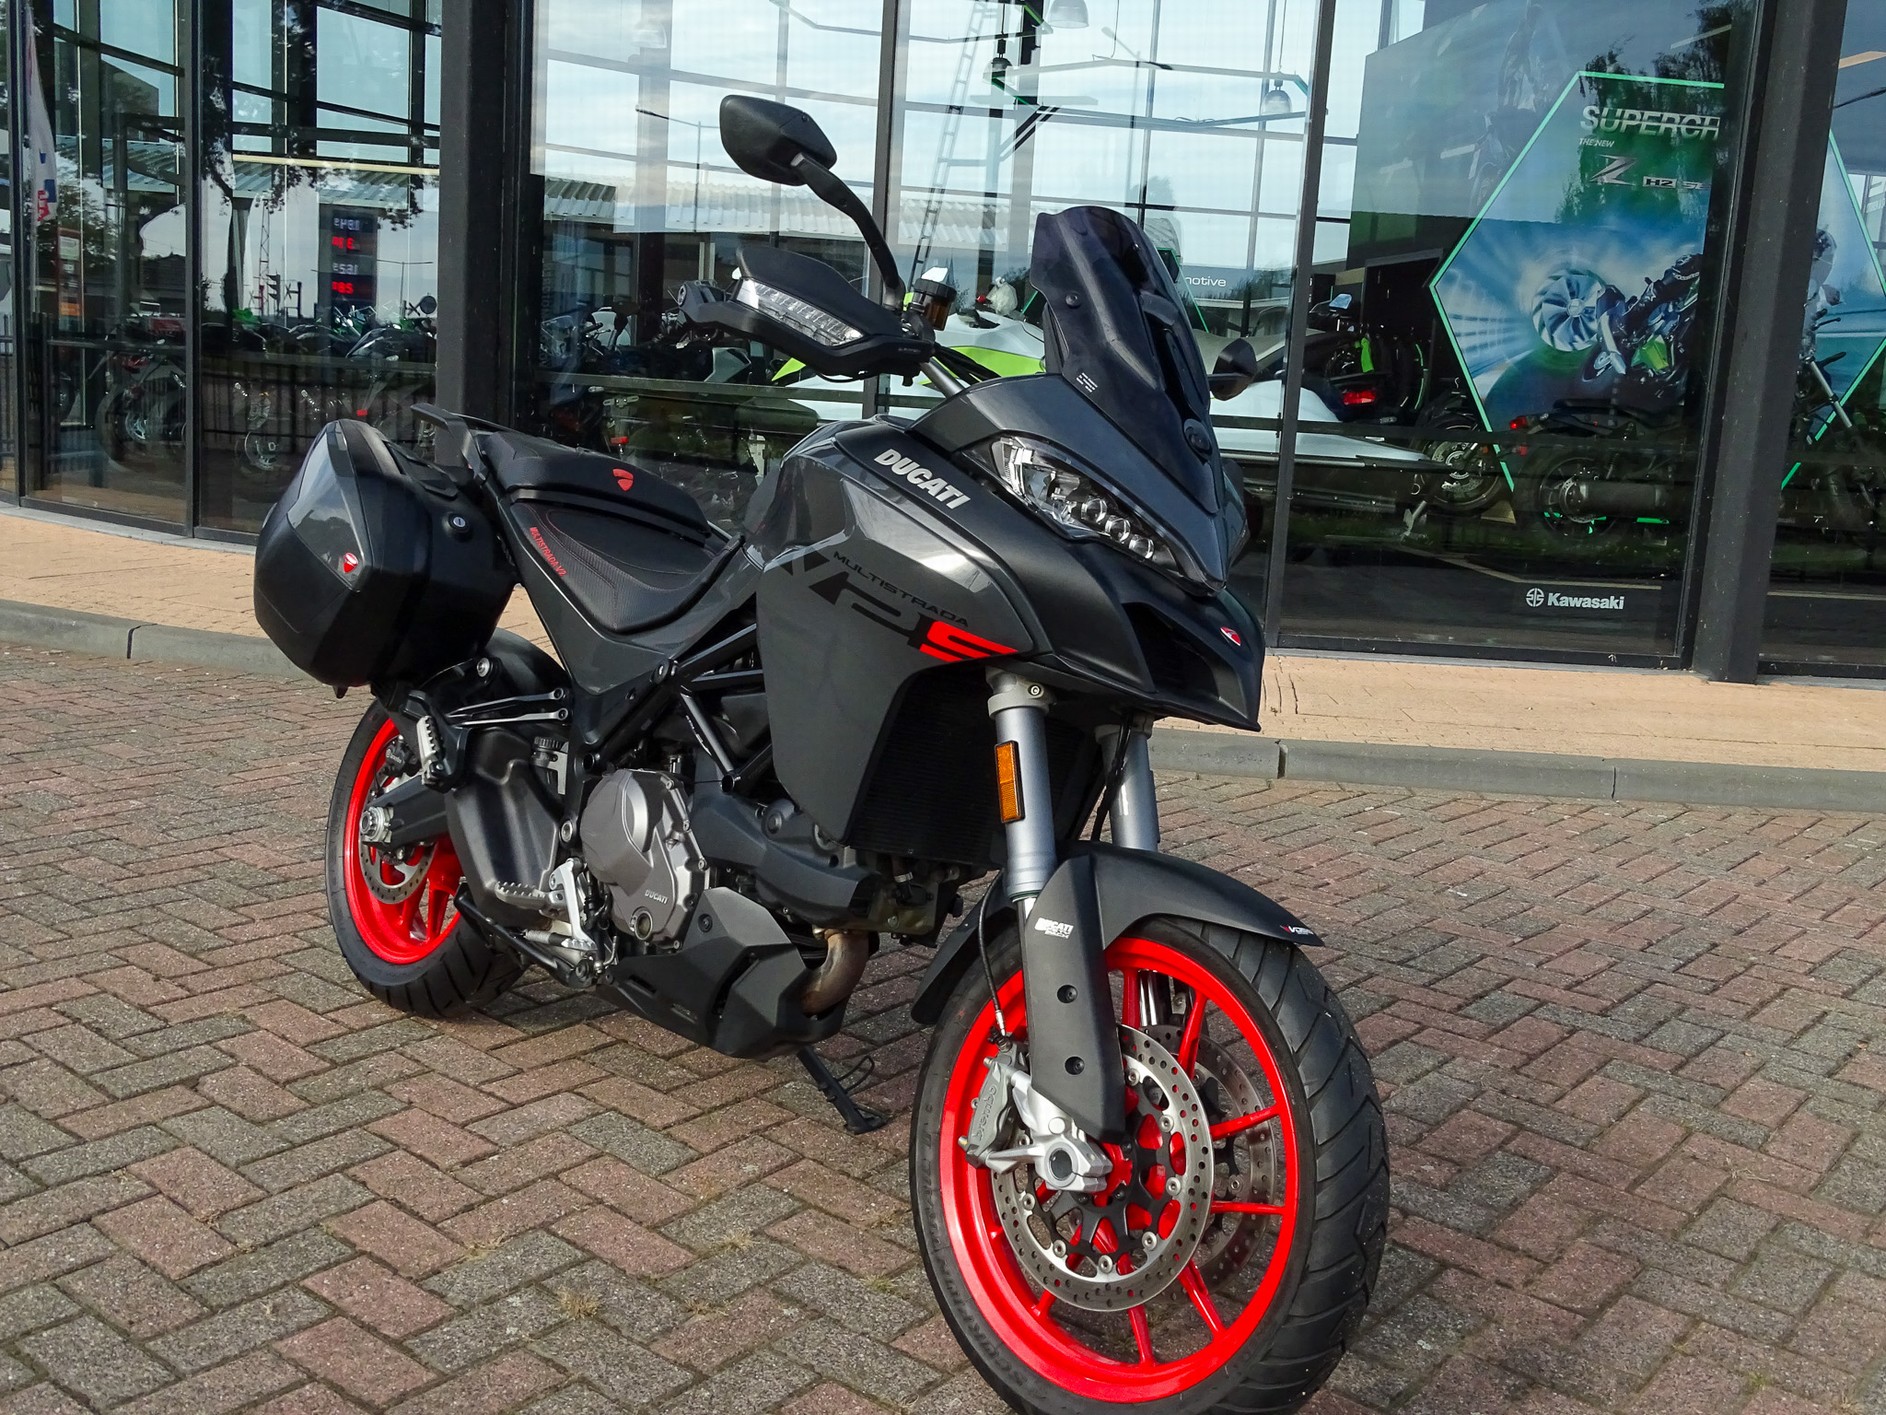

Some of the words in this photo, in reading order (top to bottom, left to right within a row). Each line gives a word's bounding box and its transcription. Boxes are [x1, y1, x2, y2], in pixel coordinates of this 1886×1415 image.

[1579, 137, 1597, 146] THE
[1594, 139, 1614, 148] NEW
[1644, 177, 1675, 188] H2
[874, 448, 971, 510] DUCATI
[833, 551, 969, 627] MULTISTRADA
[1547, 592, 1625, 610] Kawasaki
[645, 889, 668, 904] DUCATI
[971, 1085, 997, 1141] brembo
